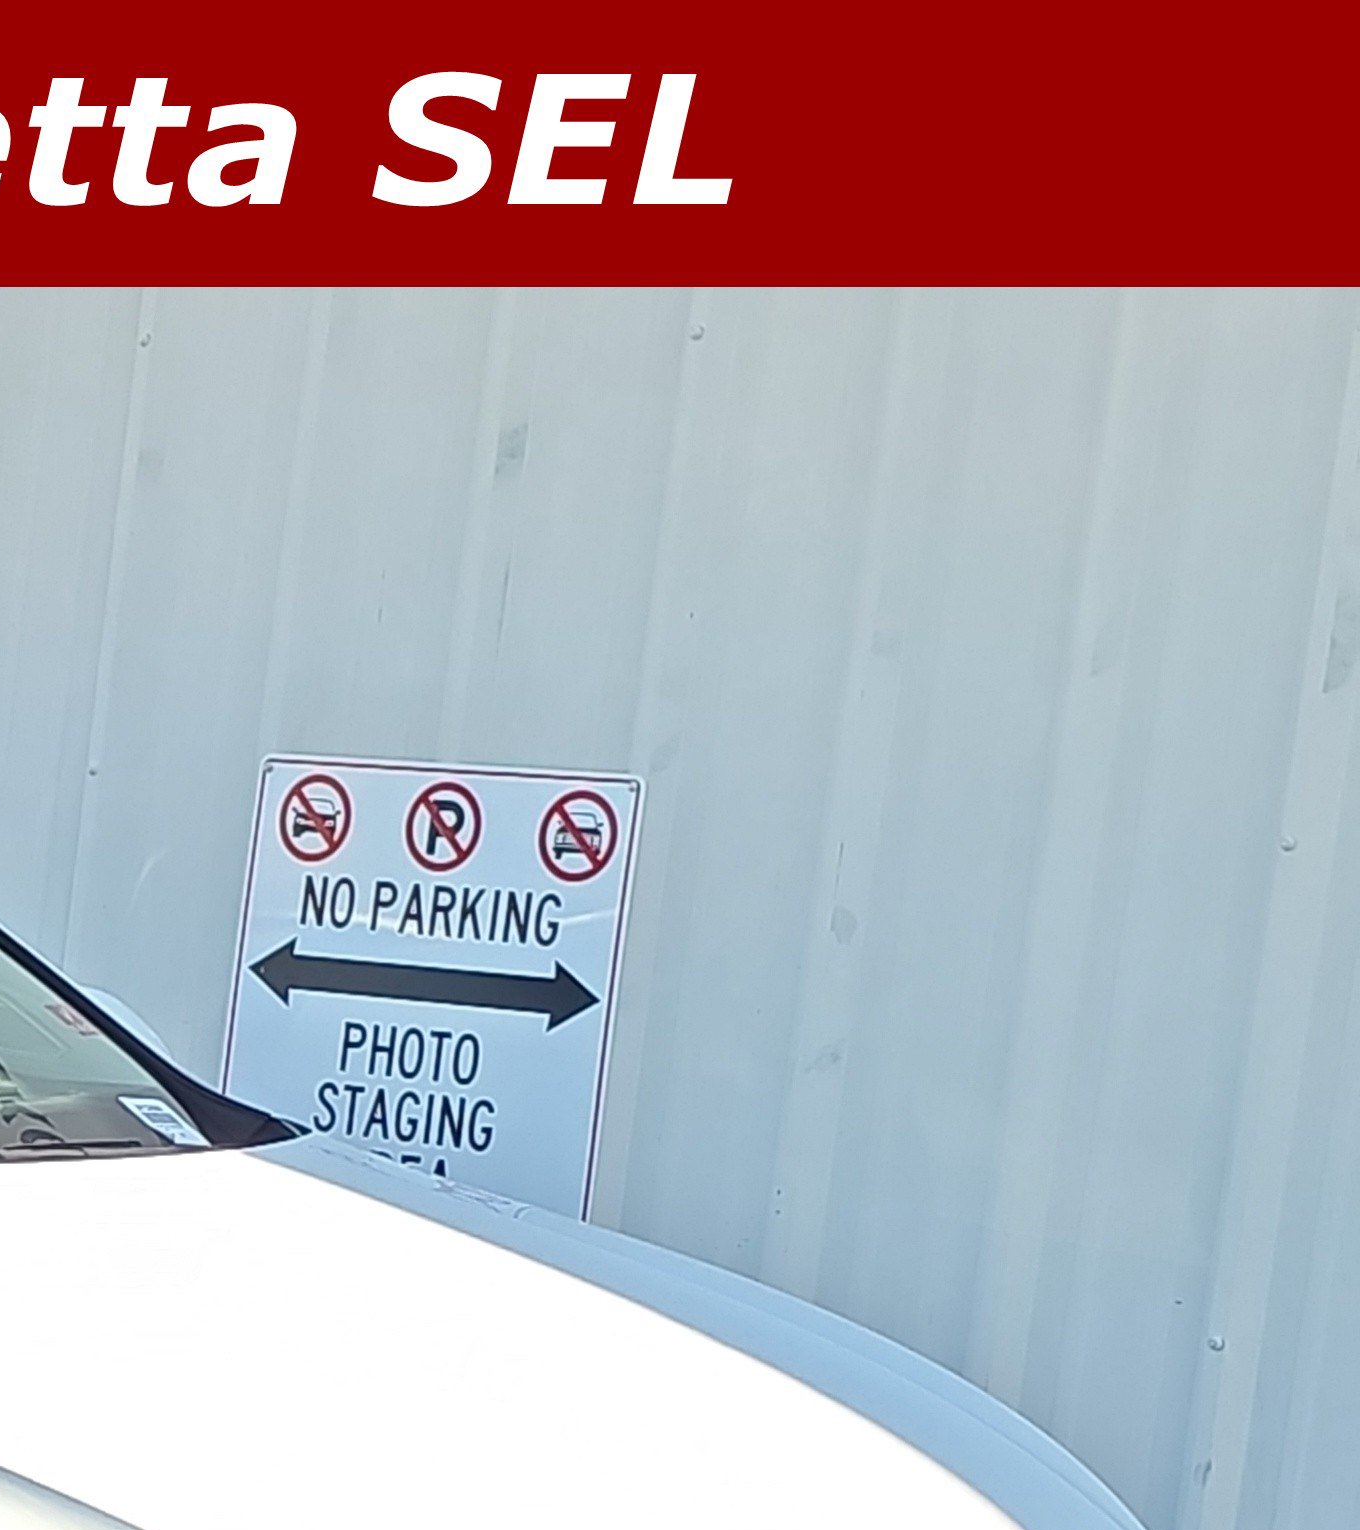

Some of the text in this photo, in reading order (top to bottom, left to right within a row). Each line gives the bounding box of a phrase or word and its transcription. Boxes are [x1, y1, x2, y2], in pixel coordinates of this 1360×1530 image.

[299, 874, 562, 947] NO PARKING
[339, 1021, 481, 1086] PHOTO
[313, 1083, 496, 1152] STAGING
